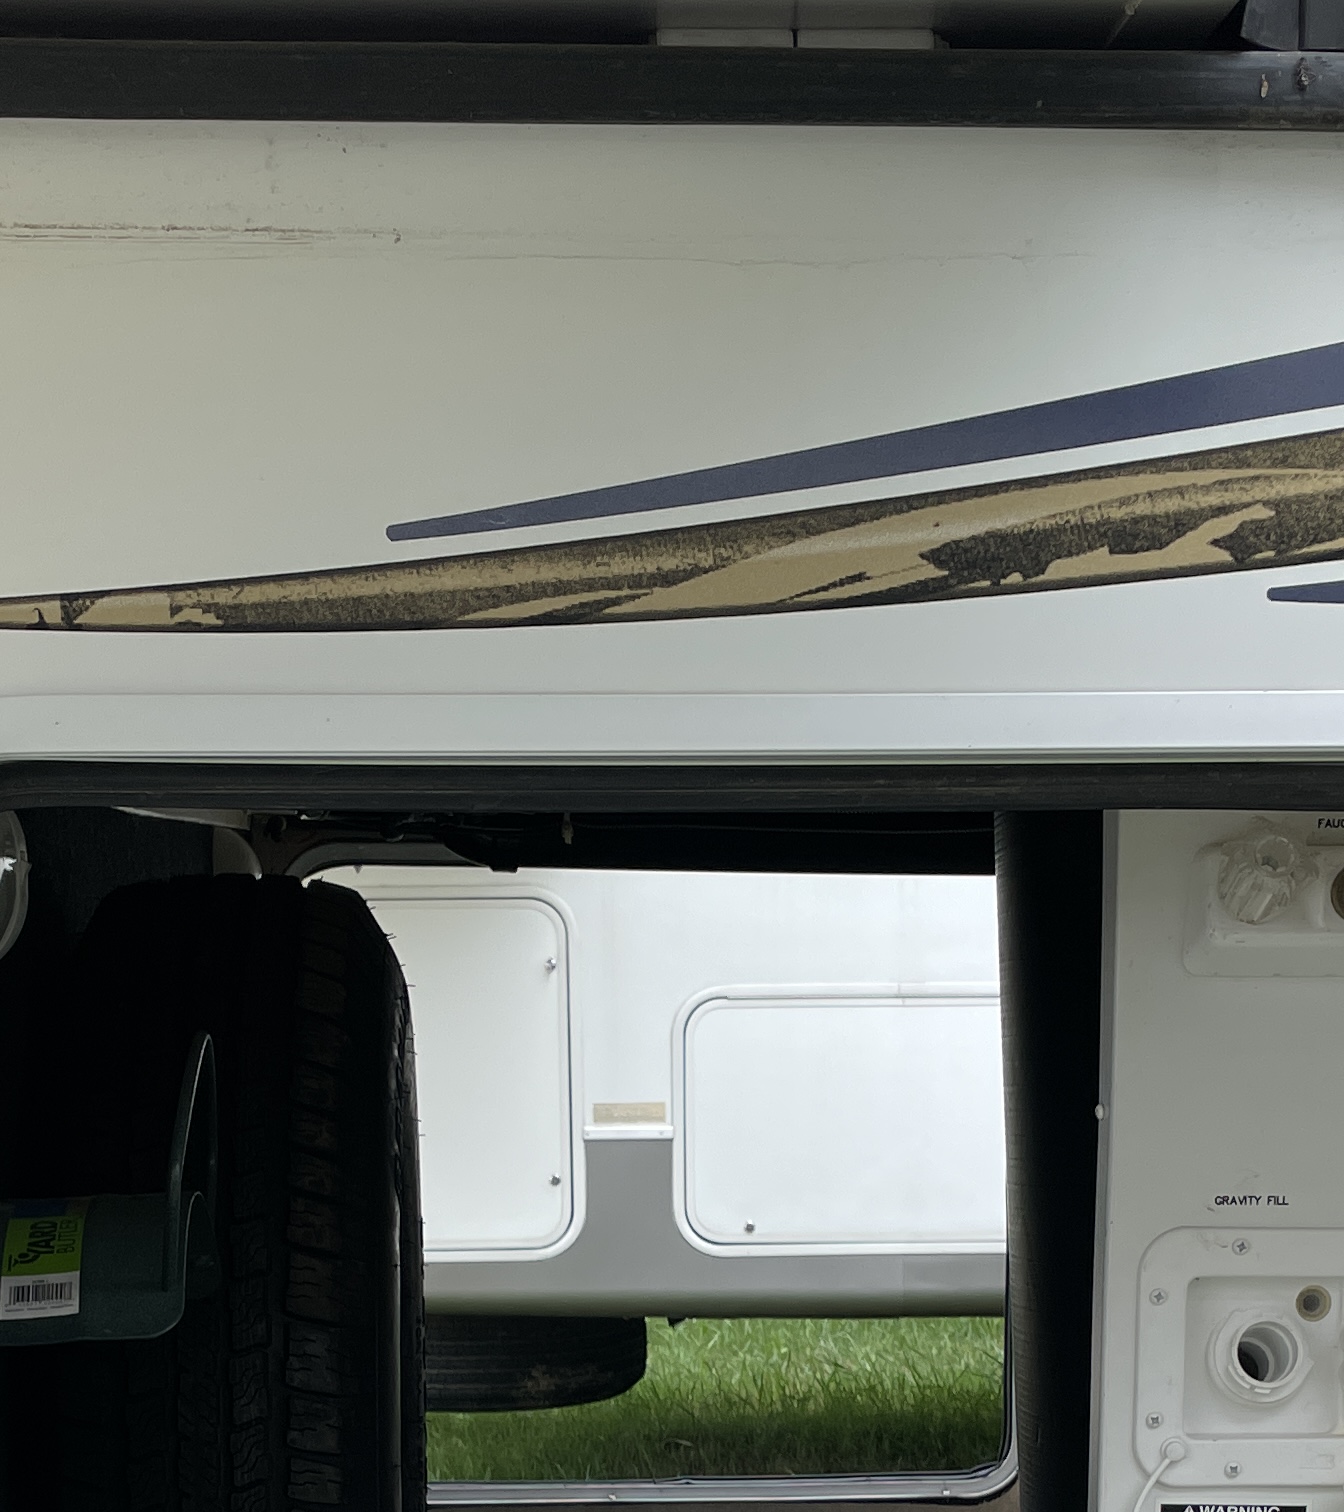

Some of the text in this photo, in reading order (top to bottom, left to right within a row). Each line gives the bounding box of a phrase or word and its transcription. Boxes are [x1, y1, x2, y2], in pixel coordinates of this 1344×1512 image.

[1214, 1195, 1290, 1206] GRAVITY FILL
[26, 1220, 58, 1256] YARD
